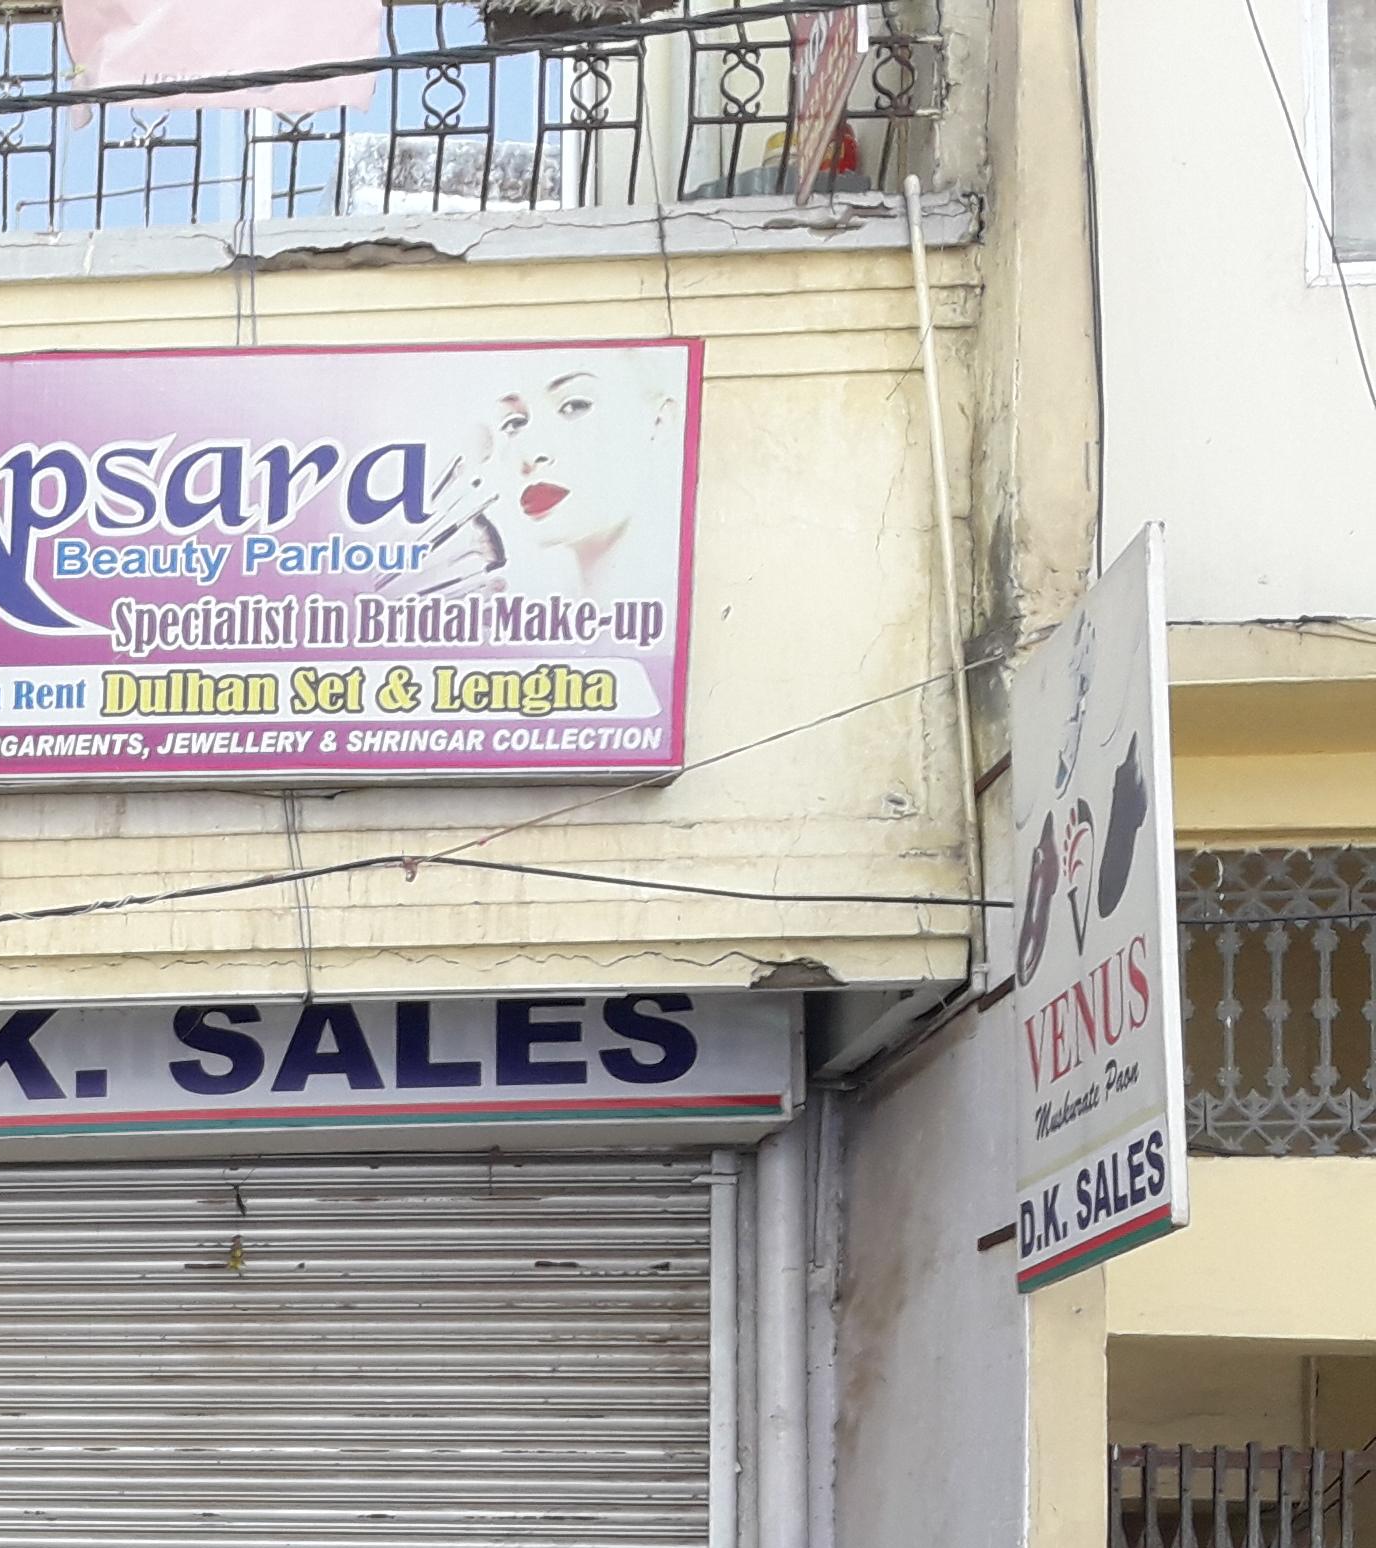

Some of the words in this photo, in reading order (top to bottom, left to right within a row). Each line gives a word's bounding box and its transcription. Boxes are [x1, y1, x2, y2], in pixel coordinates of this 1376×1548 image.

[54, 540, 227, 583] Beauty
[242, 537, 429, 575] Parlour
[112, 597, 295, 655] Specialist
[305, 598, 345, 647] in
[358, 596, 486, 645] Bridal
[491, 595, 664, 650] Make-up
[13, 678, 85, 711] Rent
[100, 669, 278, 716] Dulhan
[290, 667, 365, 713] Set
[375, 667, 419, 711] &
[431, 665, 617, 716] Lengha
[157, 731, 310, 756] JEWELLERY
[320, 730, 338, 754] &
[347, 729, 484, 754] SHRINGAR
[492, 727, 663, 752] COLLECTION
[1024, 933, 1150, 1093] VENUS
[169, 992, 699, 1097] SALES
[1020, 1182, 1068, 1259] D.K.
[1076, 1130, 1166, 1231] SALES
